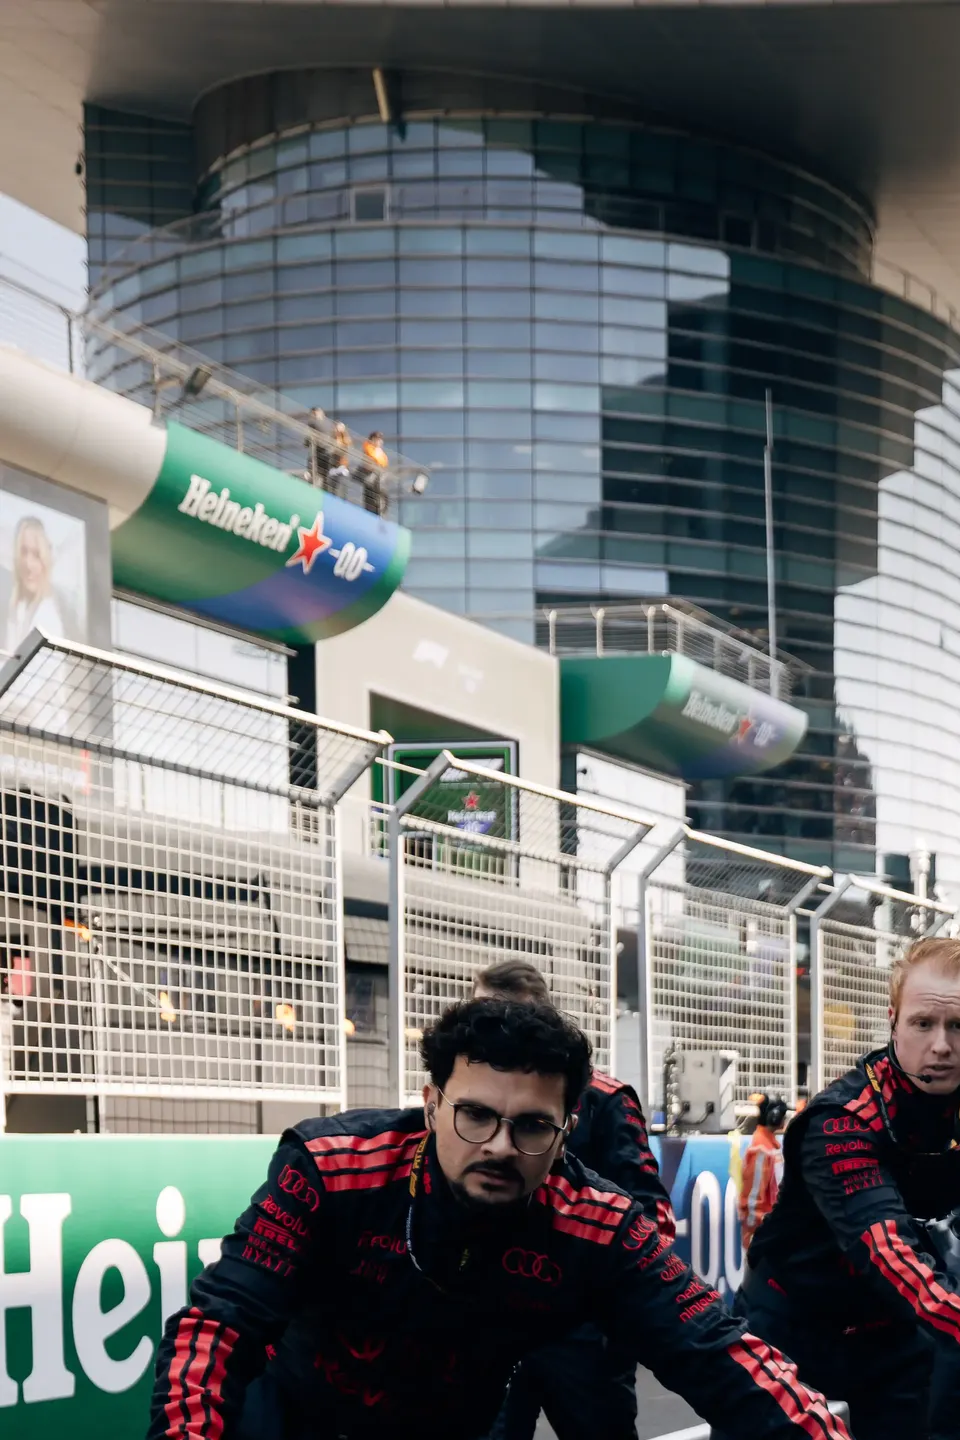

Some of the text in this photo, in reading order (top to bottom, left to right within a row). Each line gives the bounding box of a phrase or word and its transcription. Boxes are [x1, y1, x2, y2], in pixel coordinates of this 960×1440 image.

[178, 474, 298, 552] Heineken
[681, 690, 738, 735] Heineken
[0, 1186, 224, 1408] Hei
